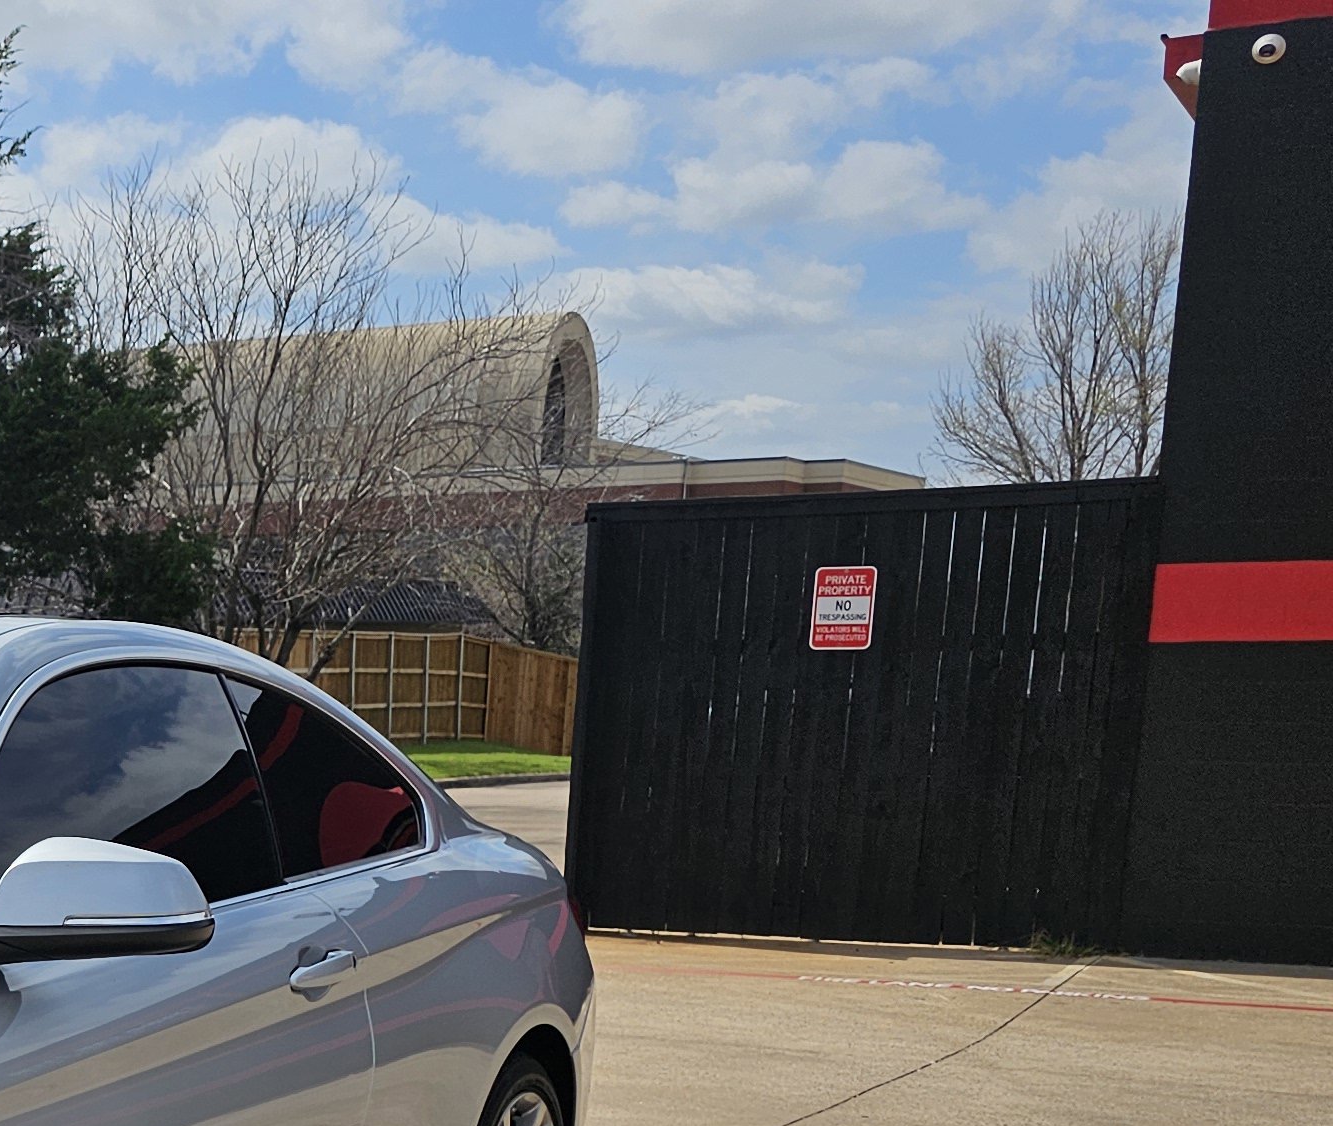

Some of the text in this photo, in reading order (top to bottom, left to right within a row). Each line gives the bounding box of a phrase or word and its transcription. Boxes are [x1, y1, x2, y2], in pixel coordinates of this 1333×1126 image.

[825, 575, 867, 585] PRIVATE
[818, 585, 871, 595] PROPERTY
[835, 600, 852, 611] NO
[819, 613, 867, 621] TRESPASSING
